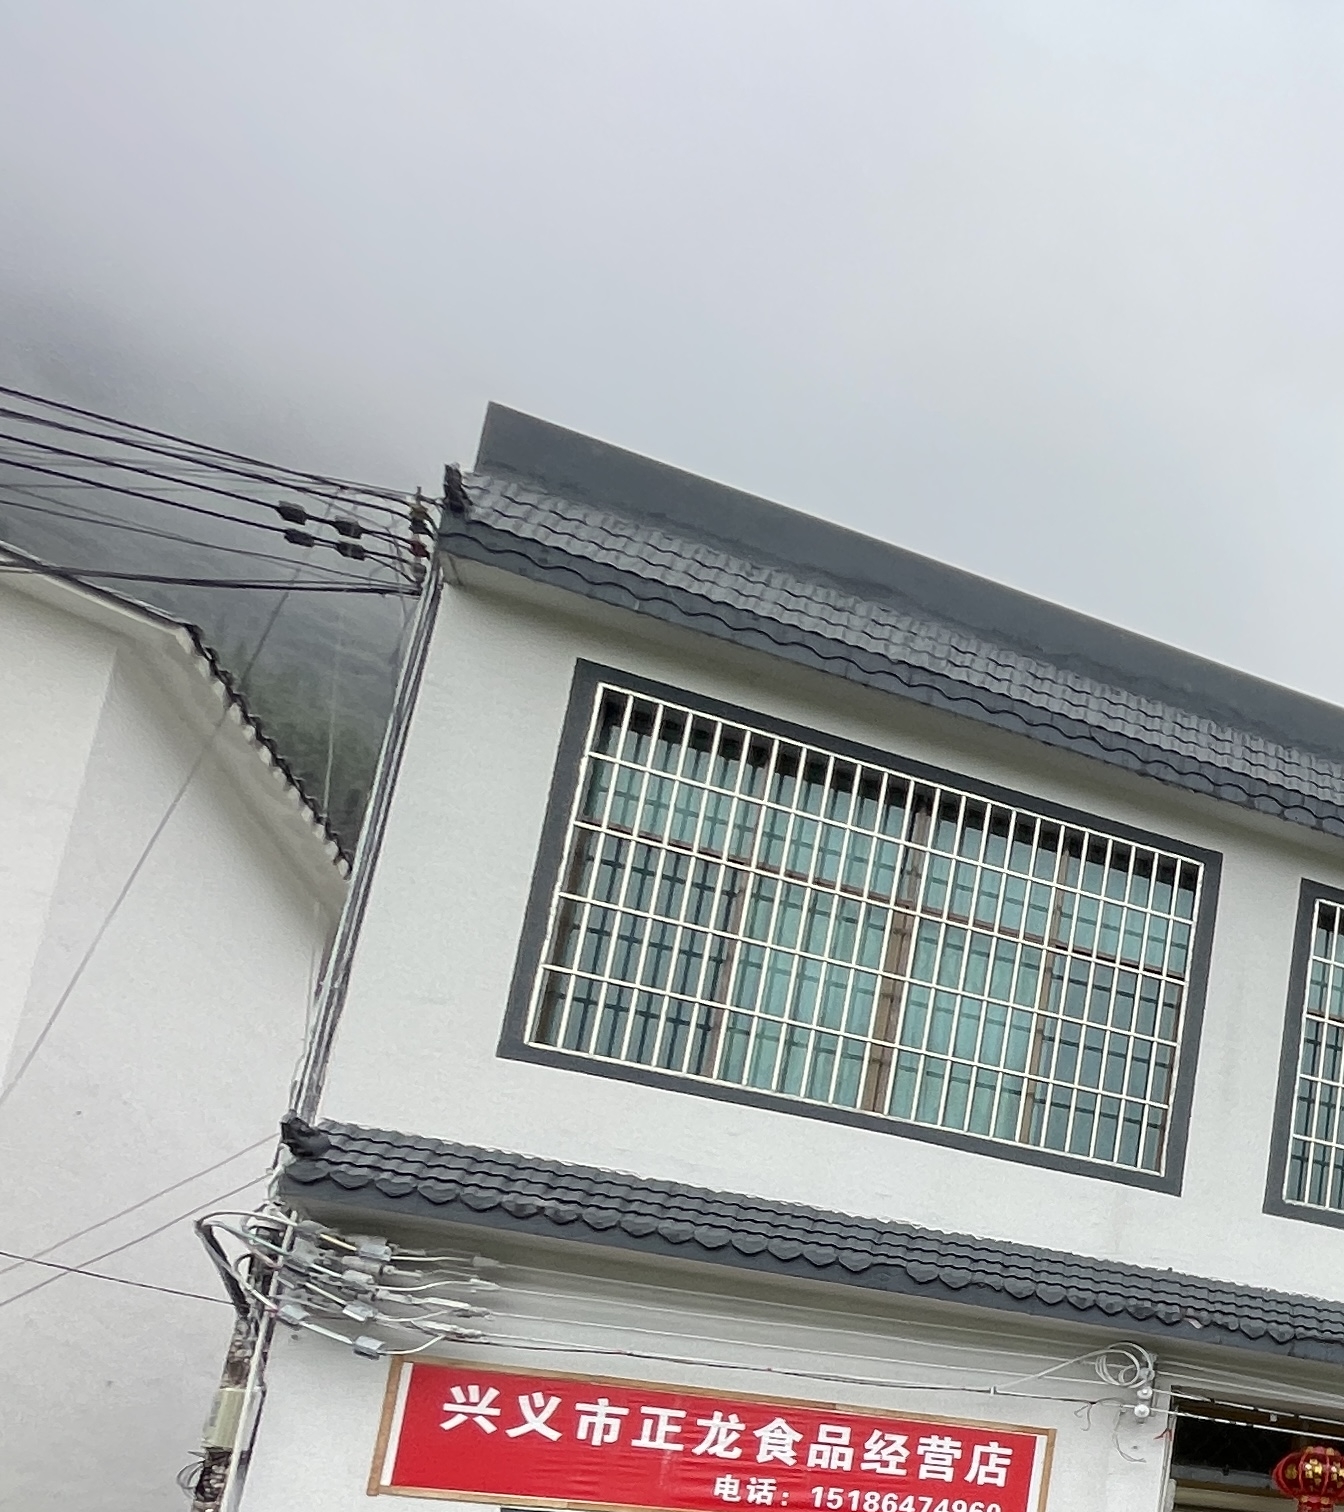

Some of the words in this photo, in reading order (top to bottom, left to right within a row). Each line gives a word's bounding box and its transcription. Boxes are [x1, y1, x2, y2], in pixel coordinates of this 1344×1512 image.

[440, 1384, 1013, 1488] 兴义市正龙食品经营店
